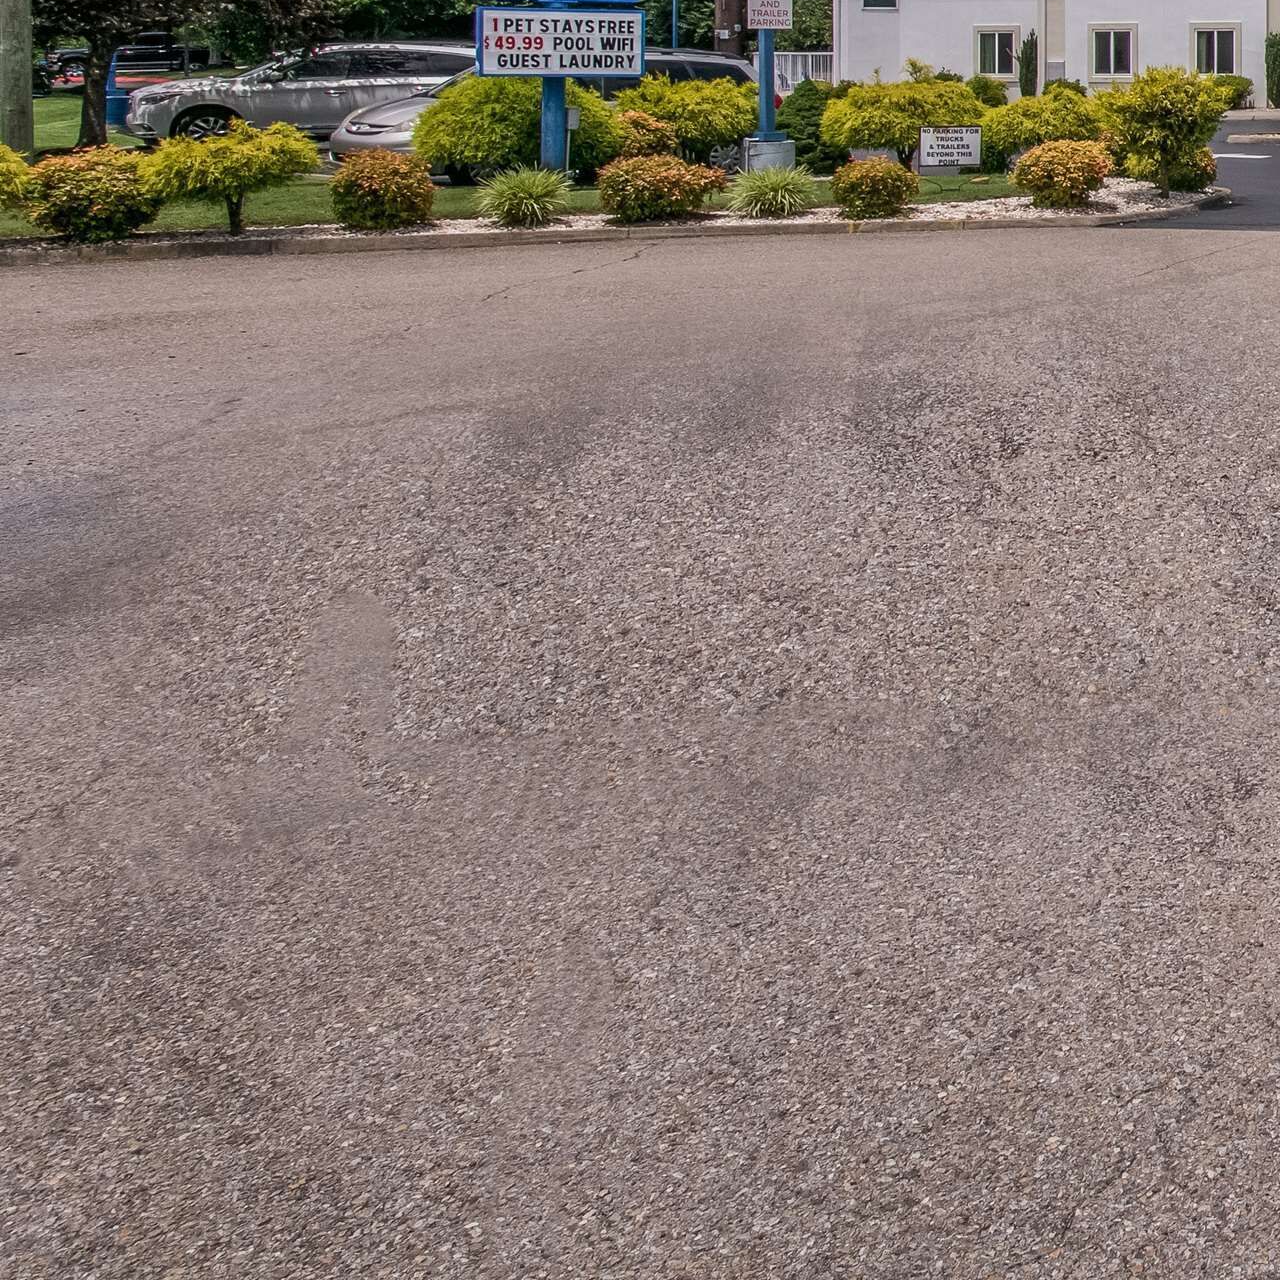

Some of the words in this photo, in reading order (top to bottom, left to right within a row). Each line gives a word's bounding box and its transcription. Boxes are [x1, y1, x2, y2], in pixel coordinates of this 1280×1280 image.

[752, 9, 789, 17] TRAILER
[492, 18, 498, 32] 1
[504, 19, 534, 33] PET
[540, 19, 595, 34] STAYS
[598, 20, 635, 34] FREE
[750, 18, 791, 27] PARKING
[553, 37, 594, 51] POOL
[600, 38, 634, 51] WIFI
[497, 54, 552, 68] GUEST
[559, 54, 635, 69] LAUNDRY
